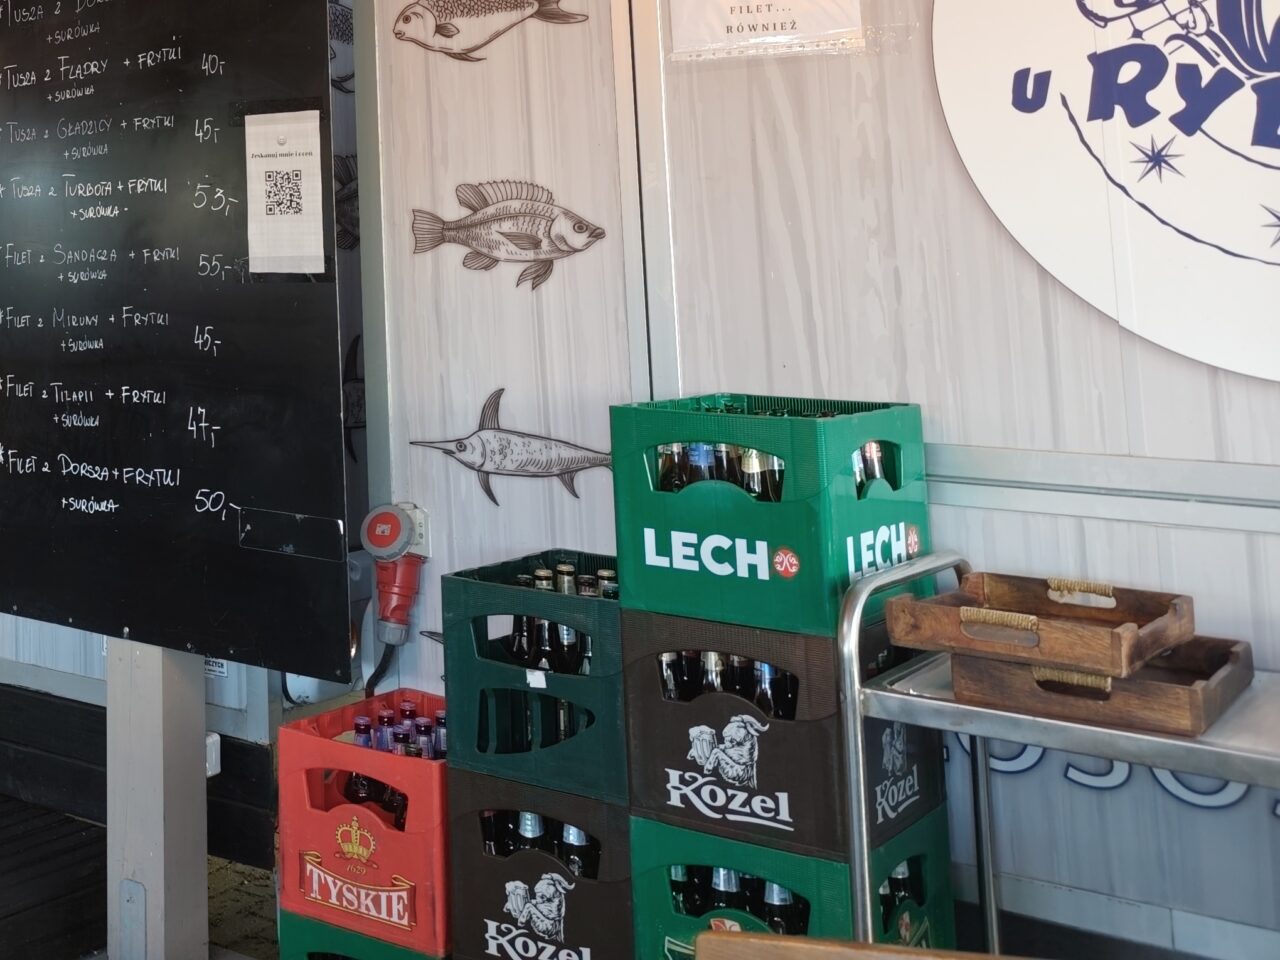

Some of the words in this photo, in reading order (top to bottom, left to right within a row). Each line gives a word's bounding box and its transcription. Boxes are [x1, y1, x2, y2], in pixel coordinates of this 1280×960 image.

[726, 19, 798, 34] RÓWNIEŻ
[643, 528, 770, 580] LECH
[846, 522, 907, 583] LECH
[664, 767, 794, 823] Kozel
[875, 763, 920, 825] Kozel
[306, 862, 409, 926] TYSKIE
[346, 864, 367, 876] 1629
